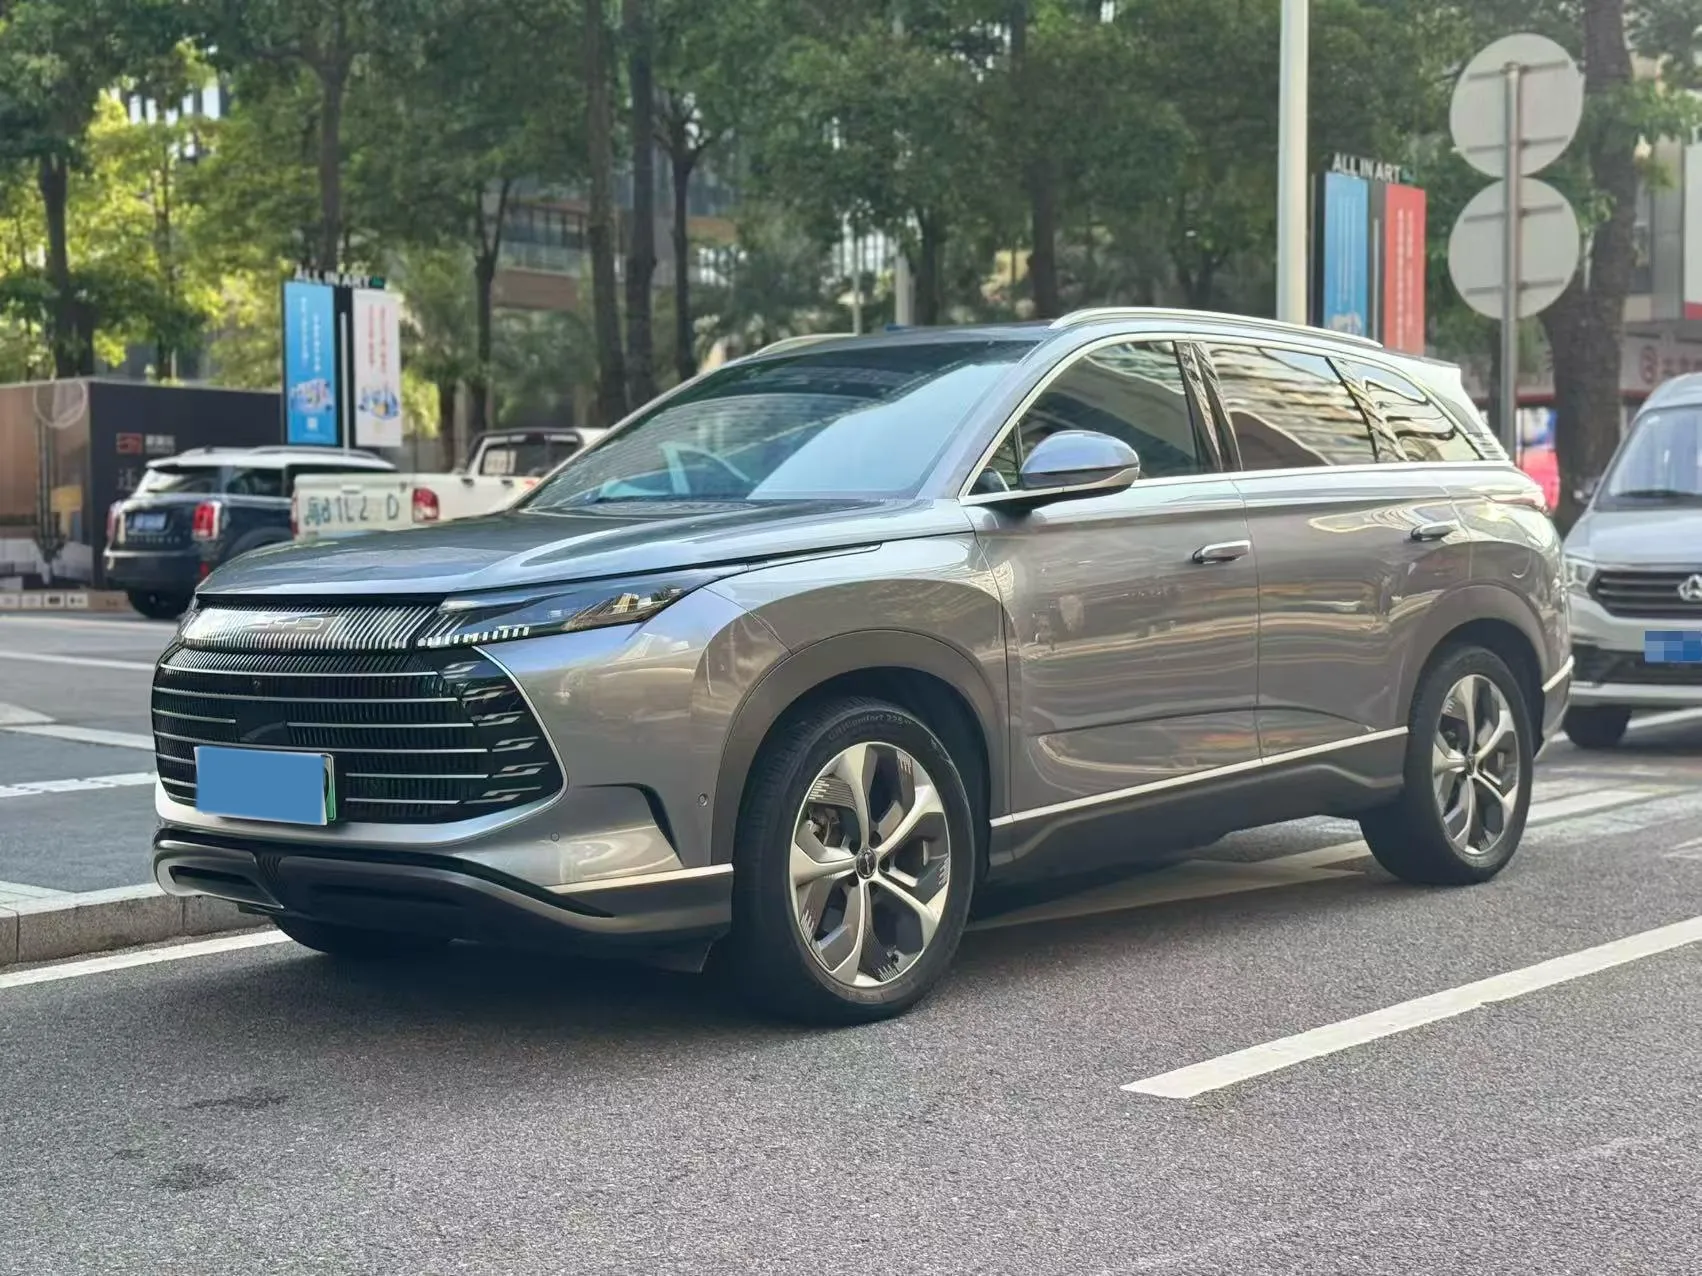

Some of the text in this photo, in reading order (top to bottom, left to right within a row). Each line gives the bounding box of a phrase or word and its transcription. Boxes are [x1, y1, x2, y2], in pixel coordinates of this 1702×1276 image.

[1333, 153, 1401, 182] ALL IN ART
